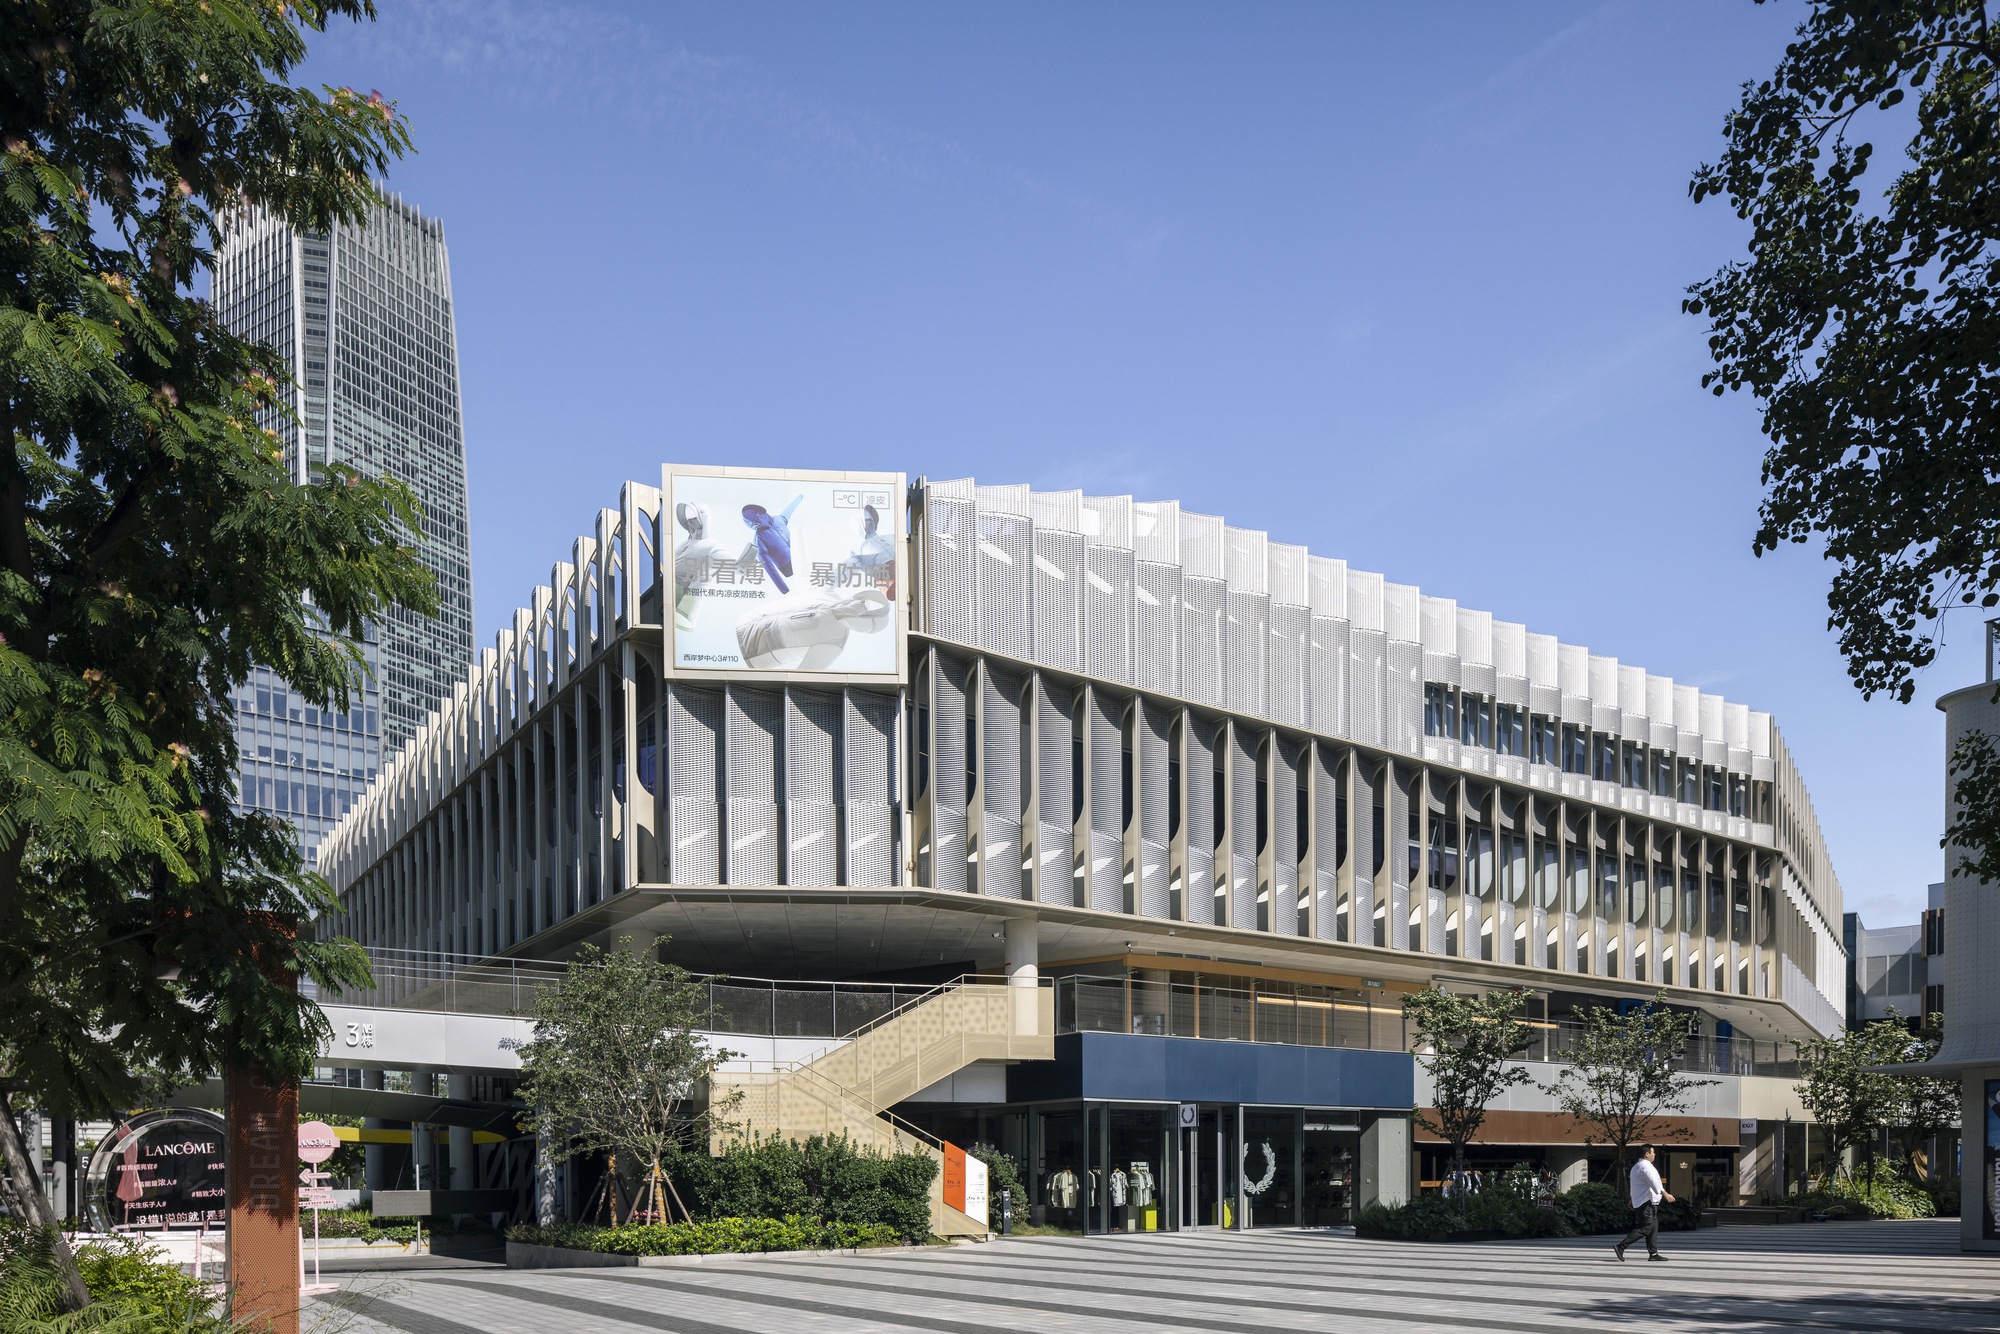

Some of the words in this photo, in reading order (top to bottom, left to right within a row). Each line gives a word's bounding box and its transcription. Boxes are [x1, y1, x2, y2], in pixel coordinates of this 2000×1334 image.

[682, 555, 766, 585] 别看薄
[809, 561, 891, 588] 暴防晒
[683, 653, 739, 663] 西岸梦中心3#110
[345, 1022, 360, 1048] 3
[145, 1141, 216, 1157] LANCÔME
[249, 1112, 281, 1210] DREAM
